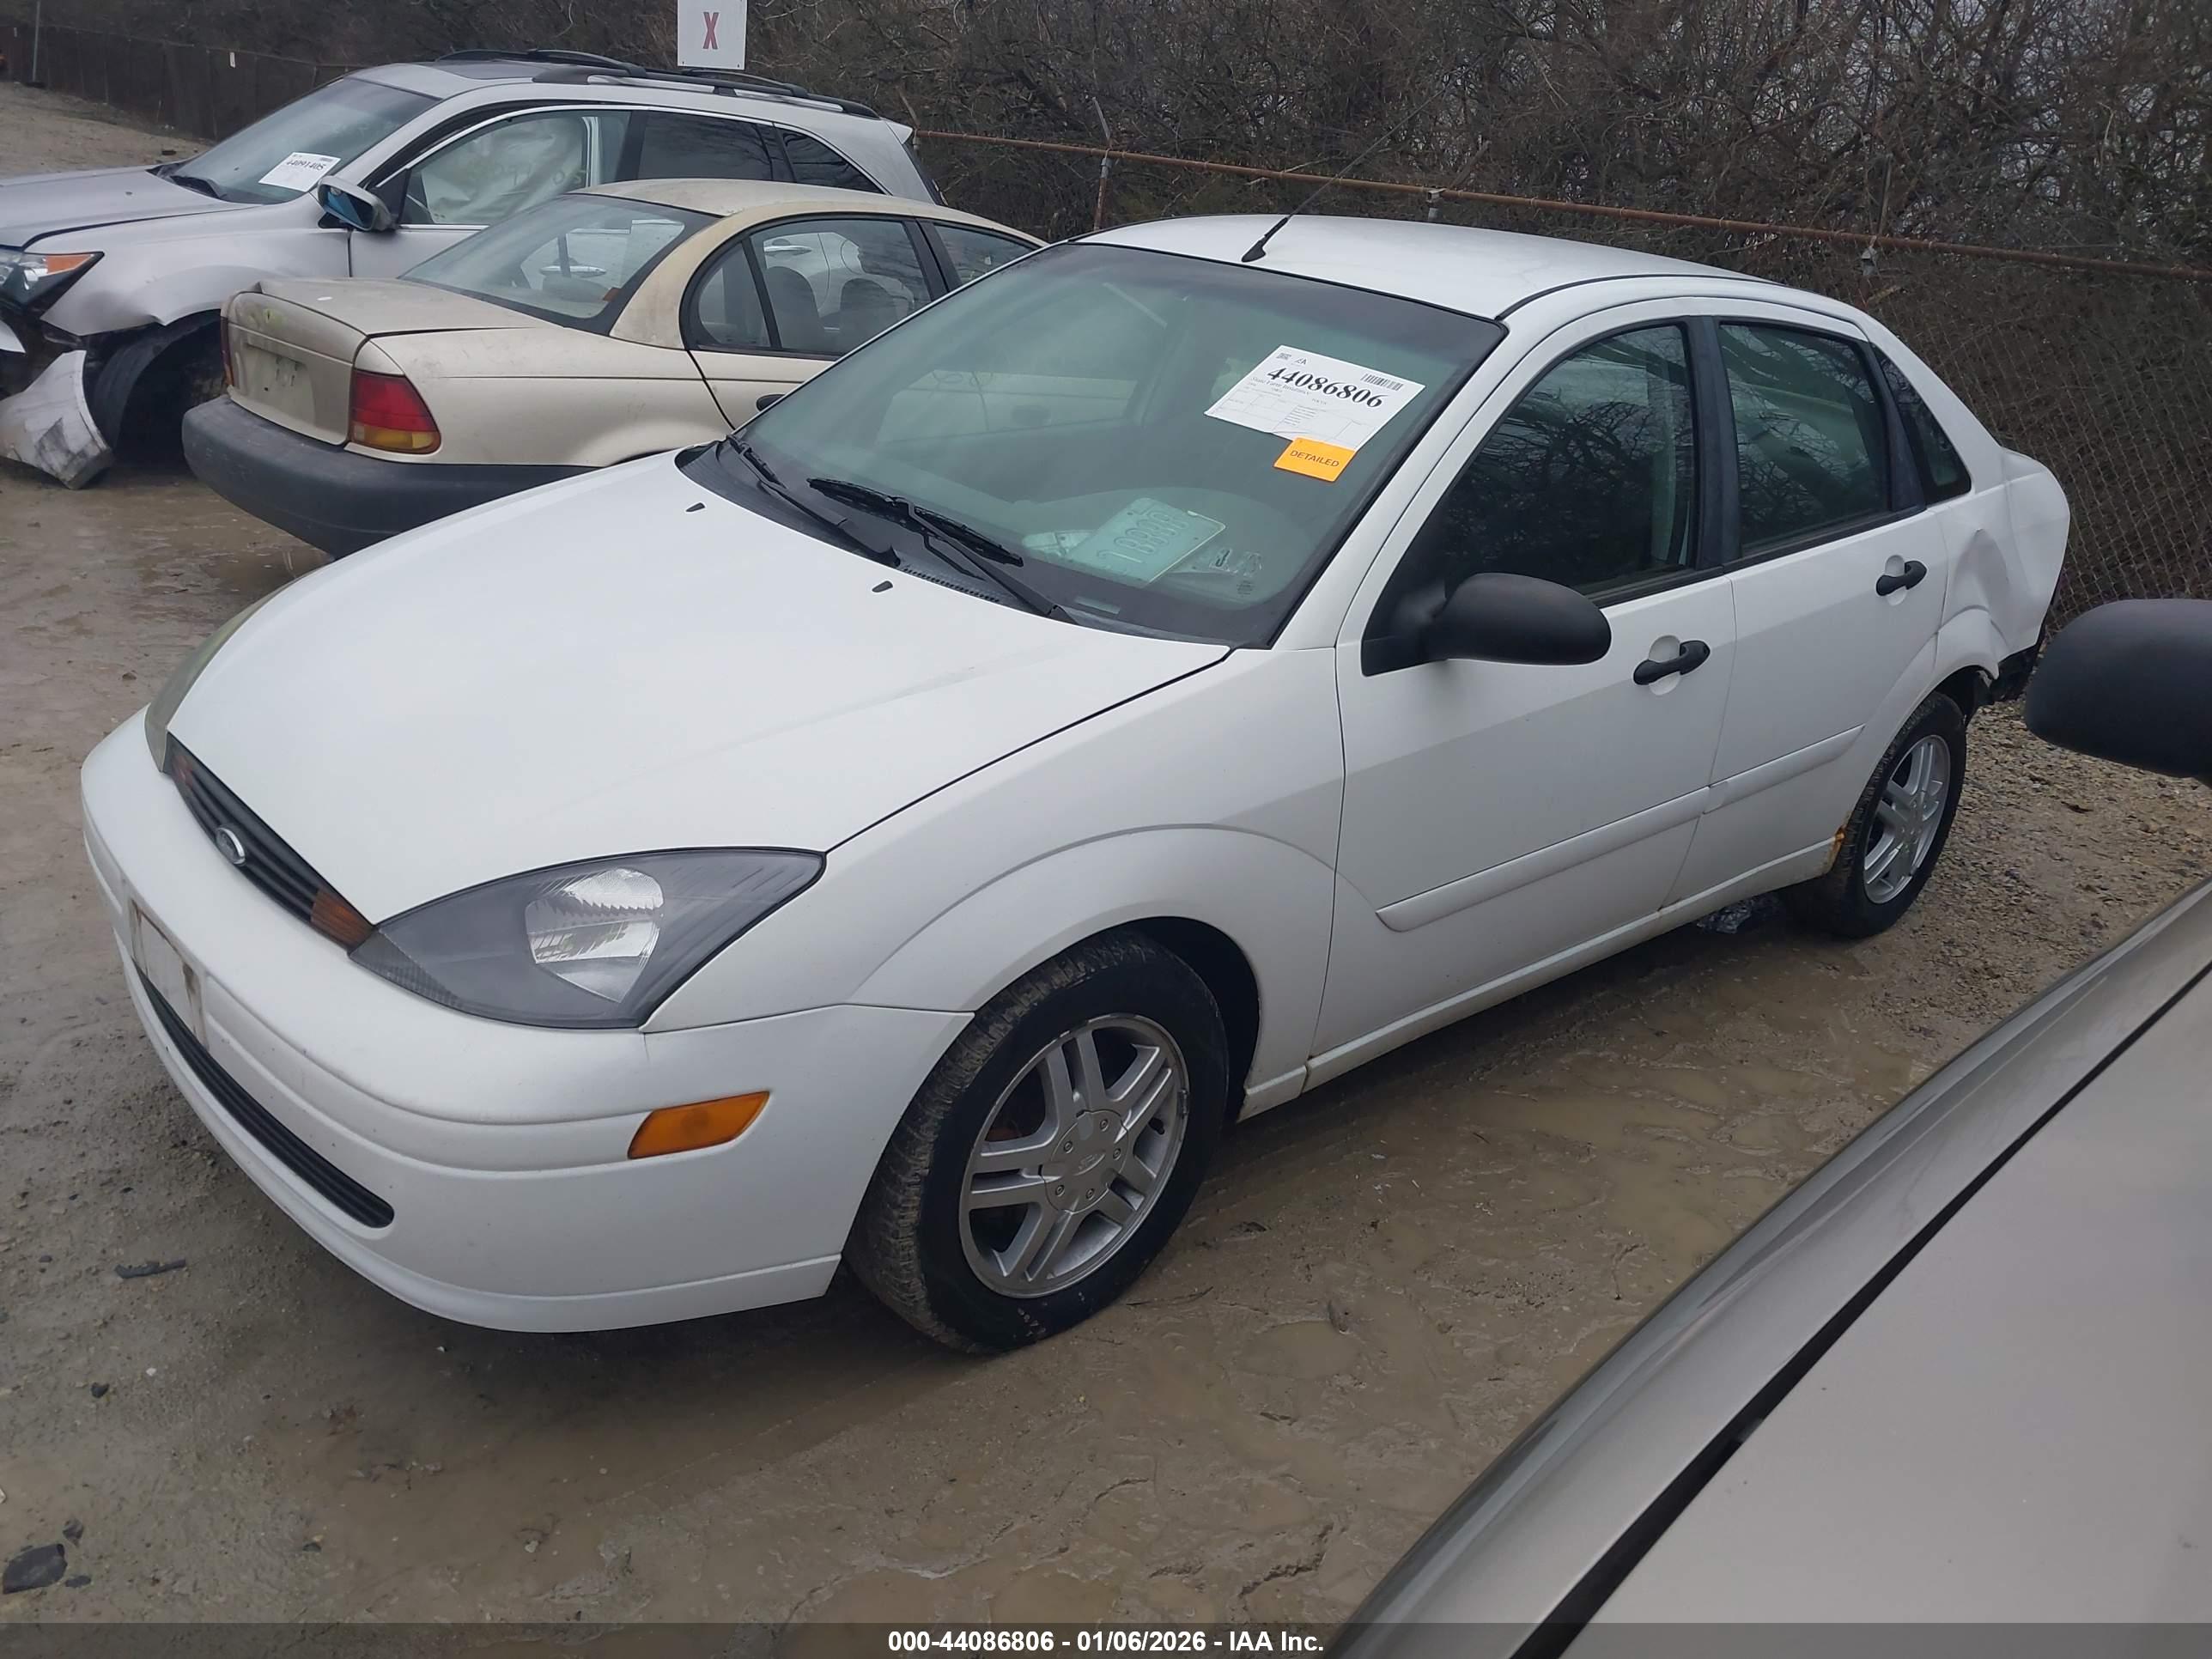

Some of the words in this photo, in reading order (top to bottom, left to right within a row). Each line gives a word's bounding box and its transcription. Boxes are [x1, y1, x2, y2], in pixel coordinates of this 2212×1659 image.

[702, 11, 720, 50] X
[1267, 368, 1388, 408] 44086806
[1290, 450, 1340, 468] DETAILED
